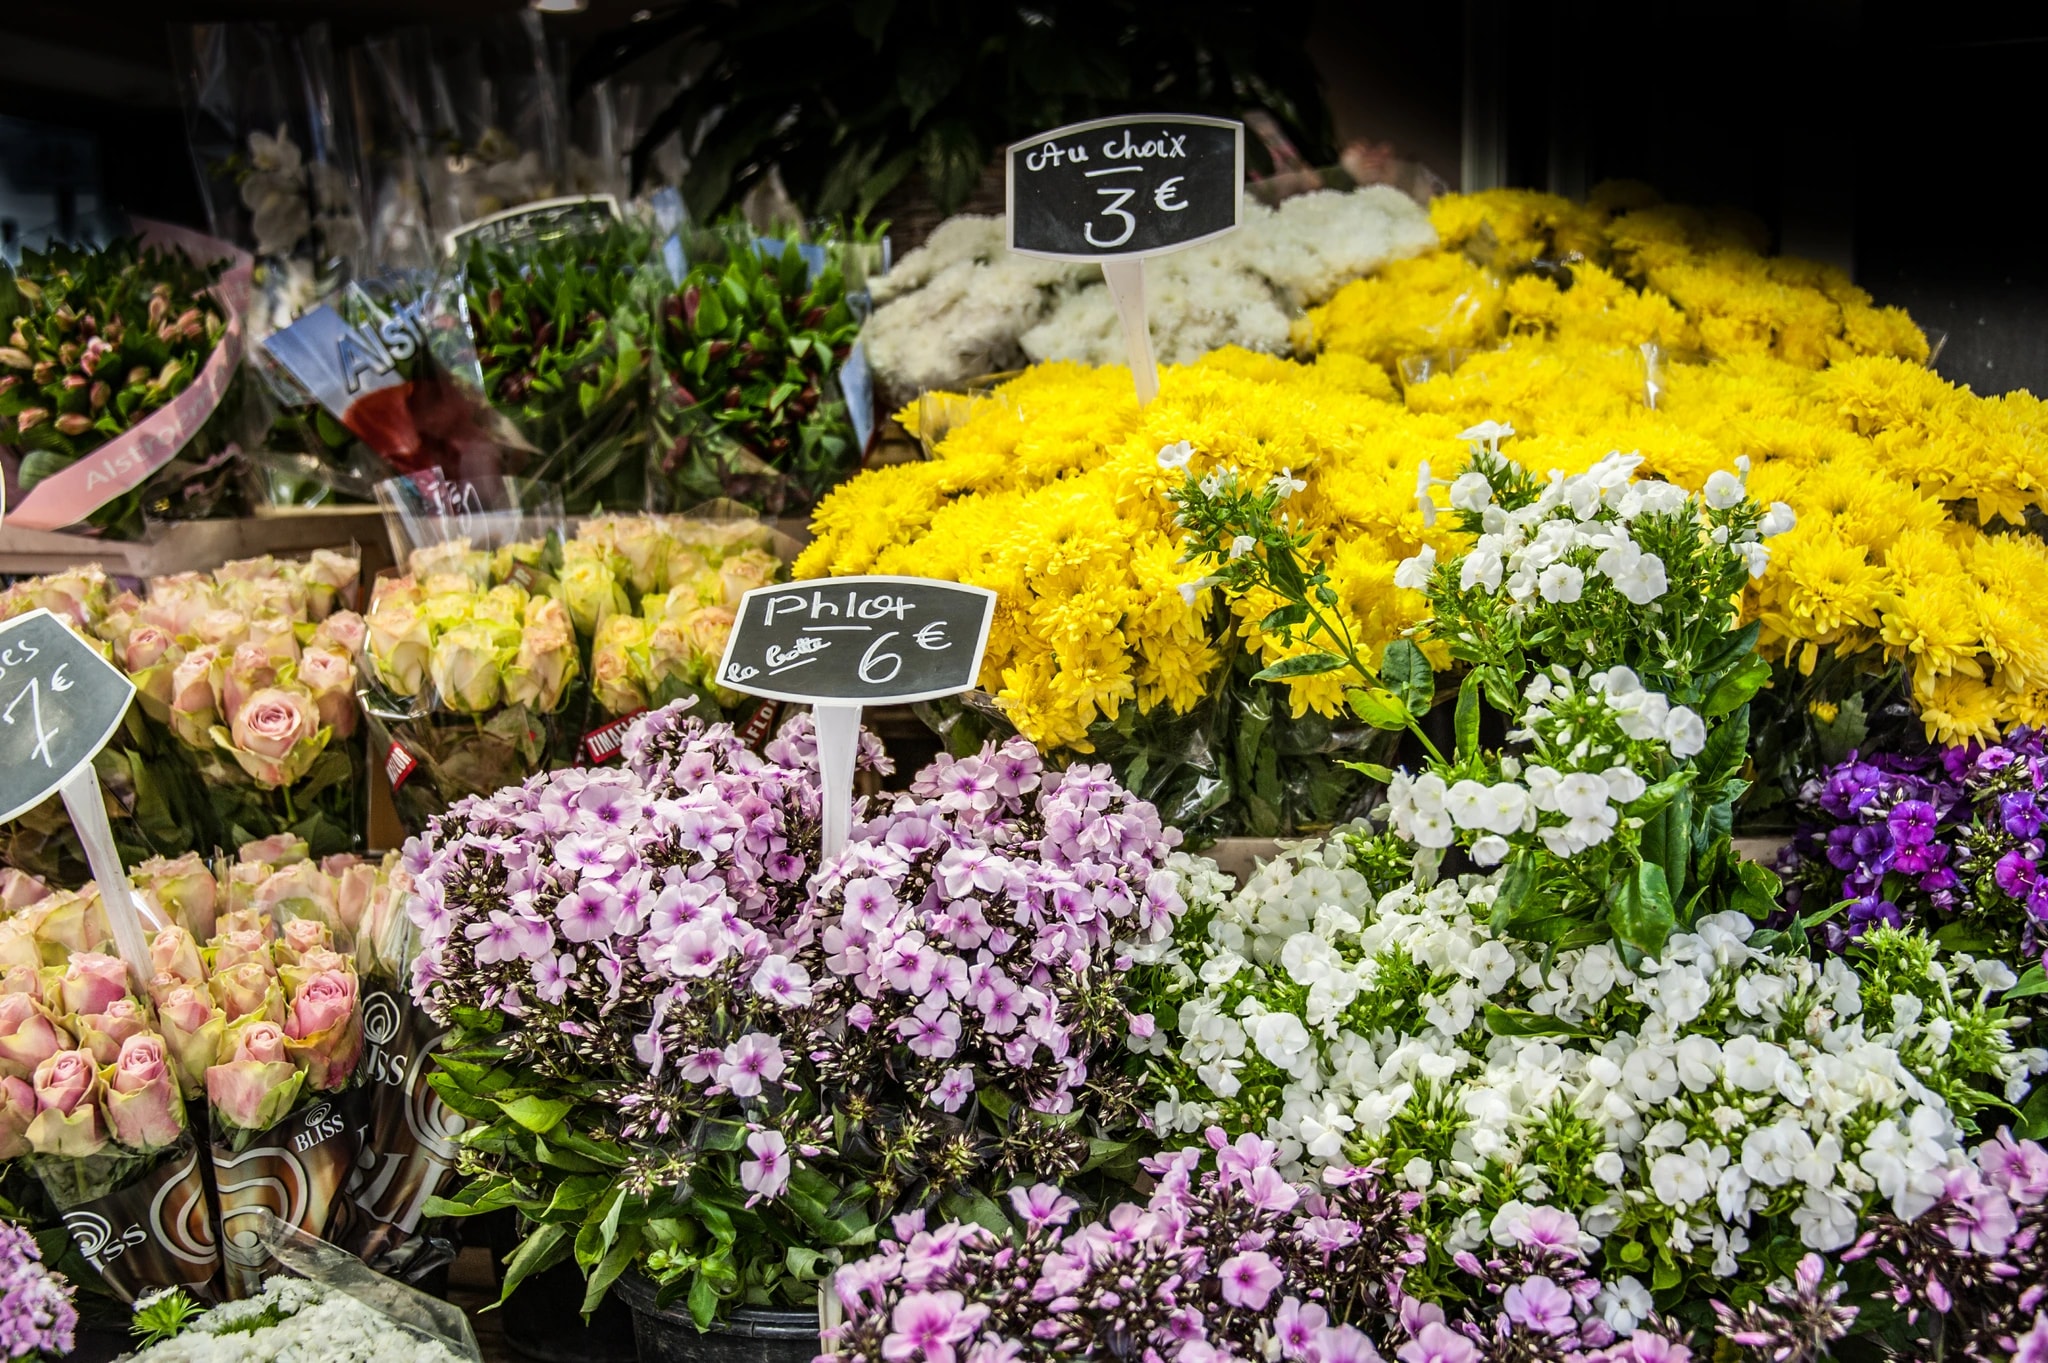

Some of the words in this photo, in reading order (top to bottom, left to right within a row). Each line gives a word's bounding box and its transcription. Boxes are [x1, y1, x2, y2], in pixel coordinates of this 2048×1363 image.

[1026, 142, 1089, 172] Au
[1103, 129, 1187, 160] choix
[1083, 188, 1136, 248] 3
[1154, 175, 1189, 212] €
[0, 639, 40, 680] es
[858, 631, 902, 684] 6
[912, 620, 953, 650] €
[294, 1113, 345, 1153] BLISS
